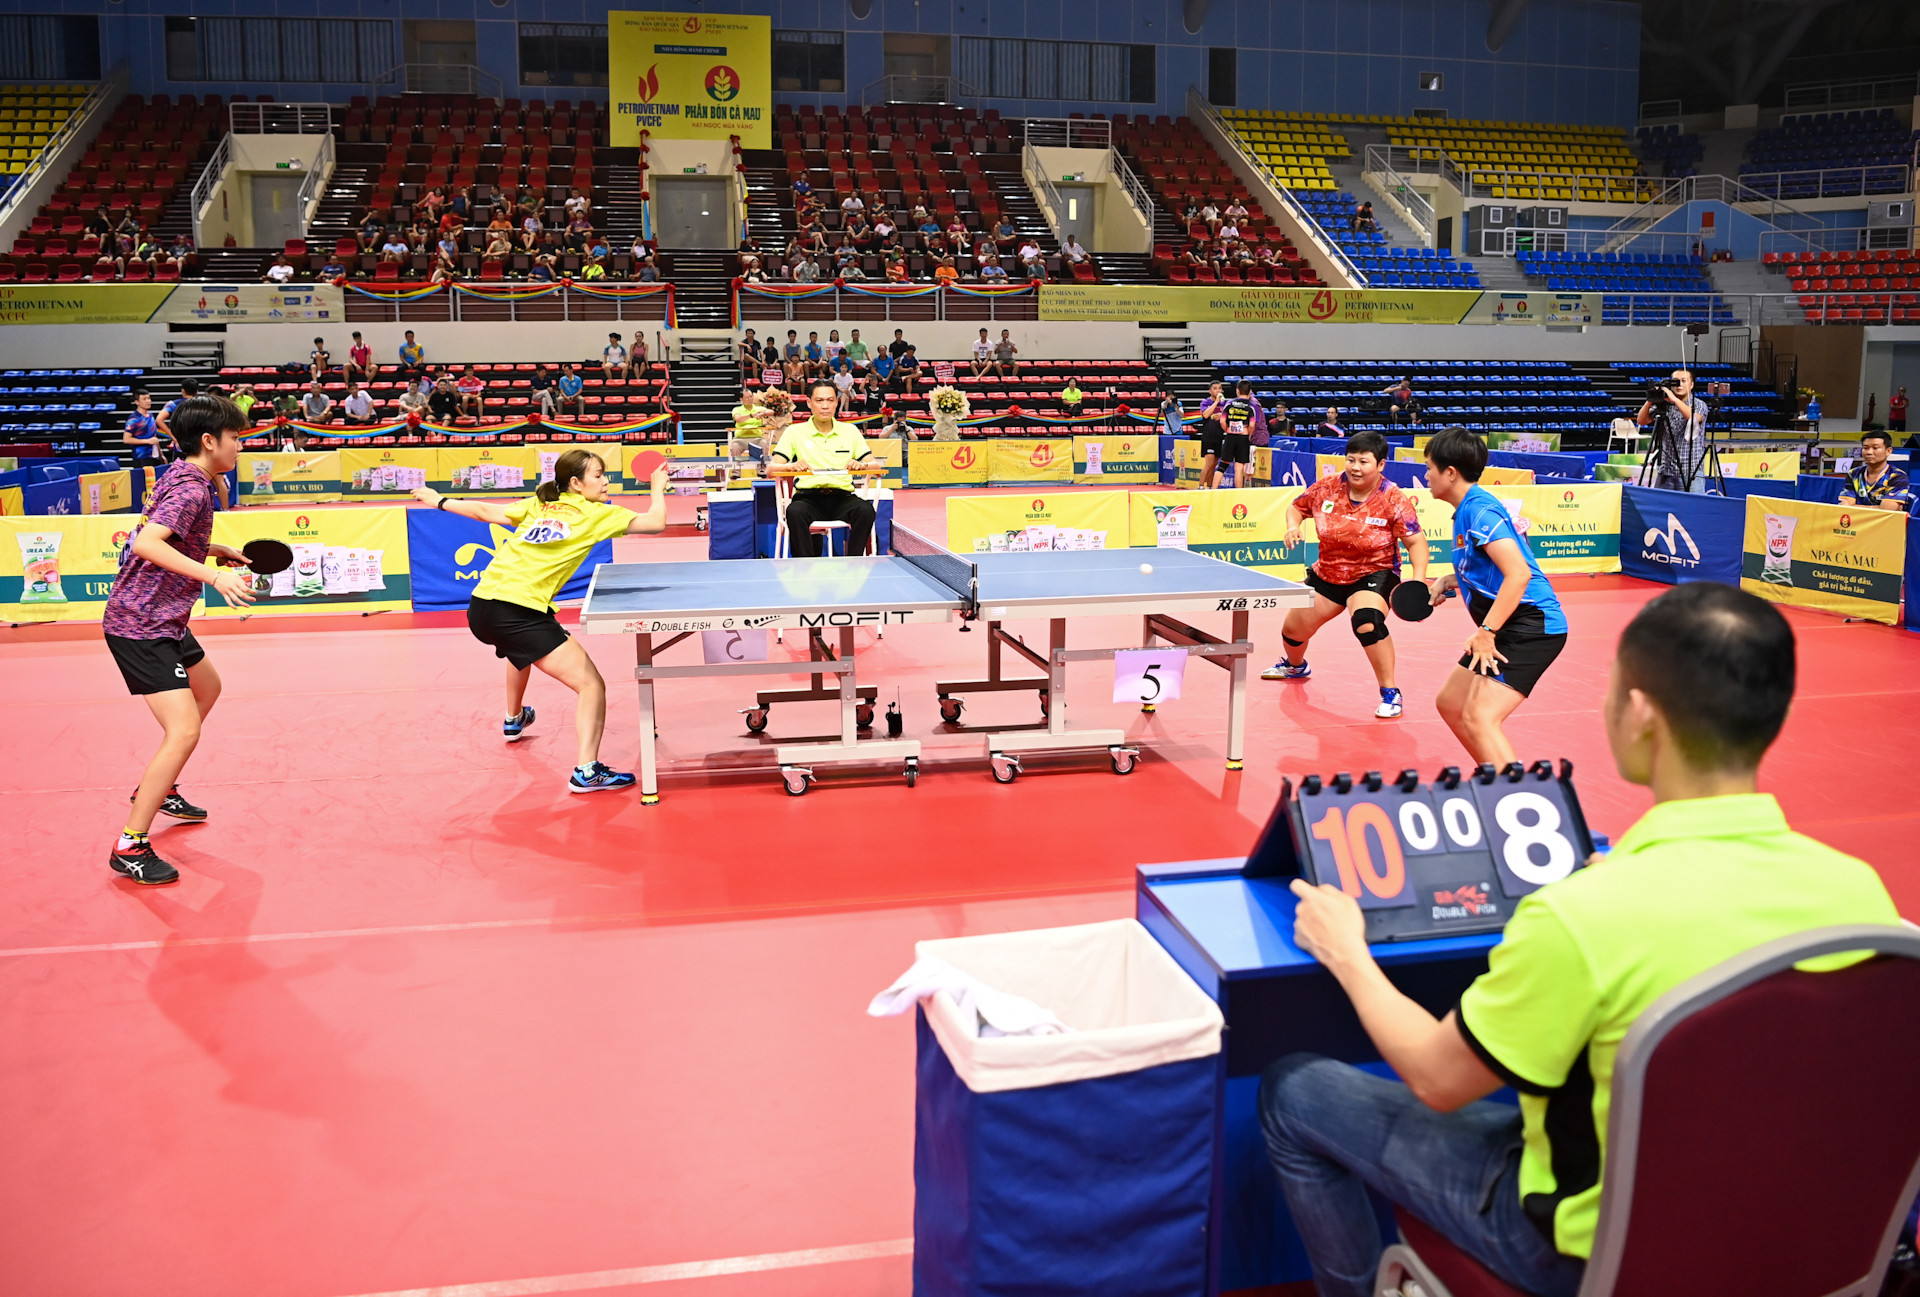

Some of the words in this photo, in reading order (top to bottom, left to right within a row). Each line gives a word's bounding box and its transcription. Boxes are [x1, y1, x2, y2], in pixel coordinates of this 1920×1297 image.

[618, 103, 680, 115] PETROVIETNAM
[685, 103, 708, 118] PHÂN
[710, 104, 727, 119] BÓN
[729, 104, 741, 120] CÀ
[743, 107, 761, 120] MAU
[636, 116, 662, 127] PVCFC
[0, 288, 14, 298] ÚP
[1263, 289, 1275, 299] VÔ
[1344, 290, 1362, 300] CÚP
[0, 300, 83, 310] ETROVIETNAM
[1210, 299, 1235, 309] BÓNG
[1238, 299, 1255, 309] BÀN
[1259, 299, 1283, 310] QUỐC
[1312, 290, 1331, 312] 41
[1345, 302, 1414, 310] PETROVIETNAM
[0, 312, 28, 321] VCFC
[1234, 310, 1254, 318] BÁO
[1256, 310, 1279, 319] NHÂN
[1282, 310, 1300, 319] DÂN
[1345, 312, 1372, 320] PVCFC
[954, 446, 971, 464] 41
[1032, 444, 1049, 463] 41
[1842, 461, 1848, 472] 6
[1538, 524, 1559, 532] NPK
[1562, 521, 1574, 532] CÀ
[1578, 523, 1599, 532] MAU
[1423, 528, 1446, 537] MAU
[1033, 541, 1049, 549] NPK
[1771, 538, 1788, 547] NPK
[1235, 547, 1254, 562] CÀ
[1257, 548, 1289, 560] MAU
[1642, 550, 1700, 569] MOFIT
[1811, 549, 1831, 562] NPK
[1835, 551, 1849, 564] CÀ
[1852, 555, 1879, 568] MAU
[1812, 570, 1827, 580] Chất
[1829, 572, 1848, 584] lượng
[85, 582, 113, 596] UR
[1819, 580, 1829, 589] giá
[1216, 597, 1248, 611] 双鱼
[1253, 598, 1277, 608] 235
[800, 611, 914, 627] MOFIT
[651, 621, 689, 631] DOUBLE
[1140, 664, 1161, 700] 5
[1398, 800, 1438, 850] 0
[1442, 798, 1482, 847] 0
[1495, 792, 1574, 885] 8
[1311, 802, 1405, 899] 10
[1432, 906, 1468, 919] DOUBLE
[1476, 903, 1497, 914] FISH
